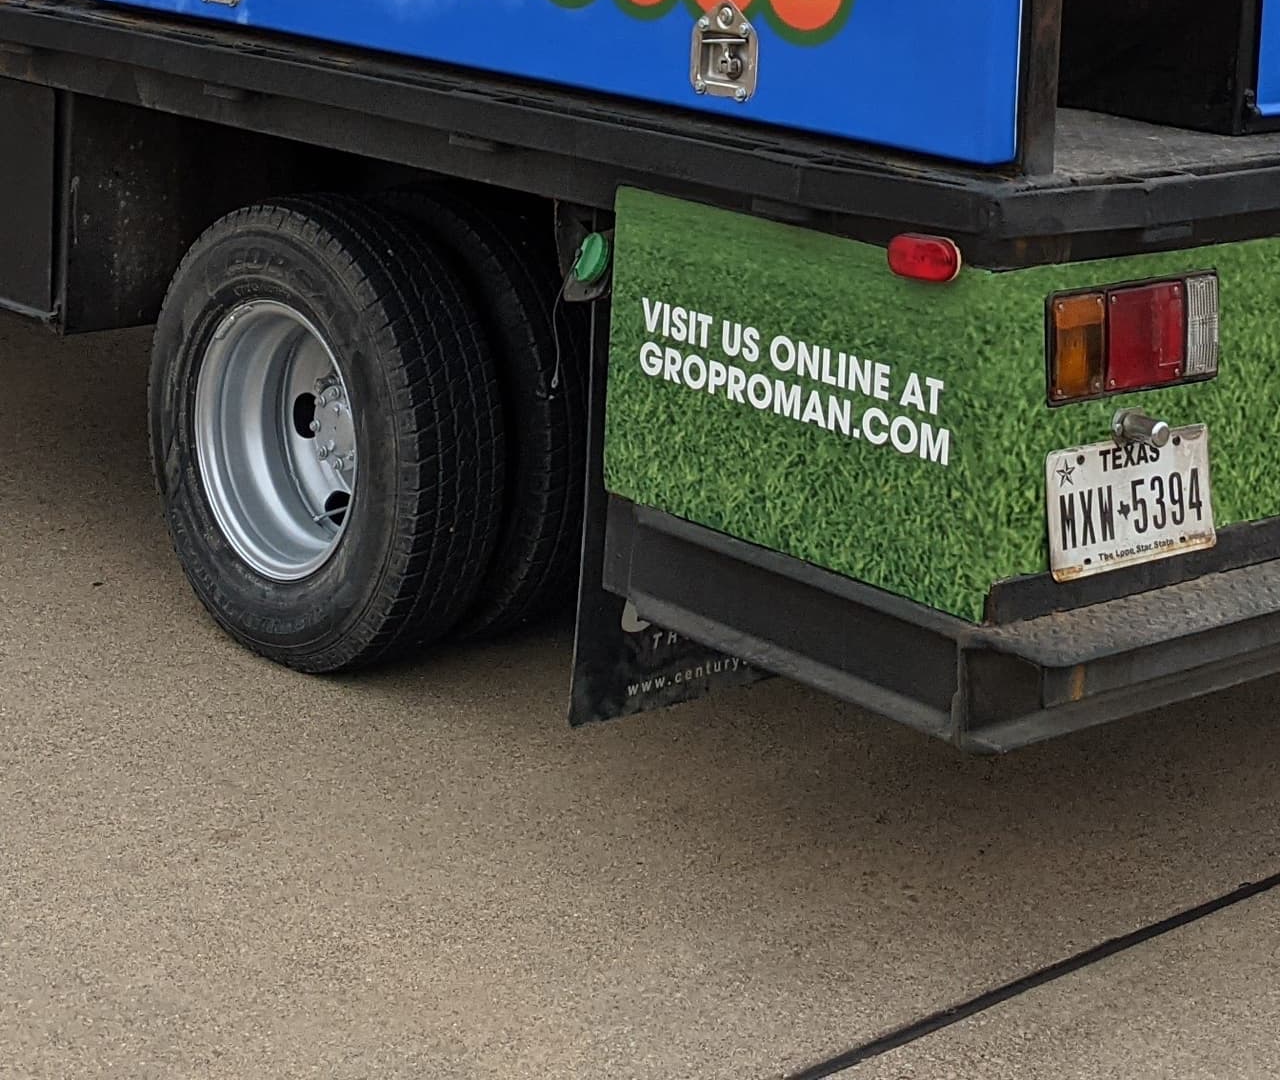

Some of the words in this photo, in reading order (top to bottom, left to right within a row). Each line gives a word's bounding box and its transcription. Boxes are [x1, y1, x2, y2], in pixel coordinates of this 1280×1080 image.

[639, 340, 951, 466] GROPROMAN.COM
[642, 297, 714, 350] VISIT
[721, 319, 761, 362] US
[769, 334, 891, 402] ONLINE
[899, 372, 945, 416] AT
[1099, 442, 1161, 472] TEXAS
